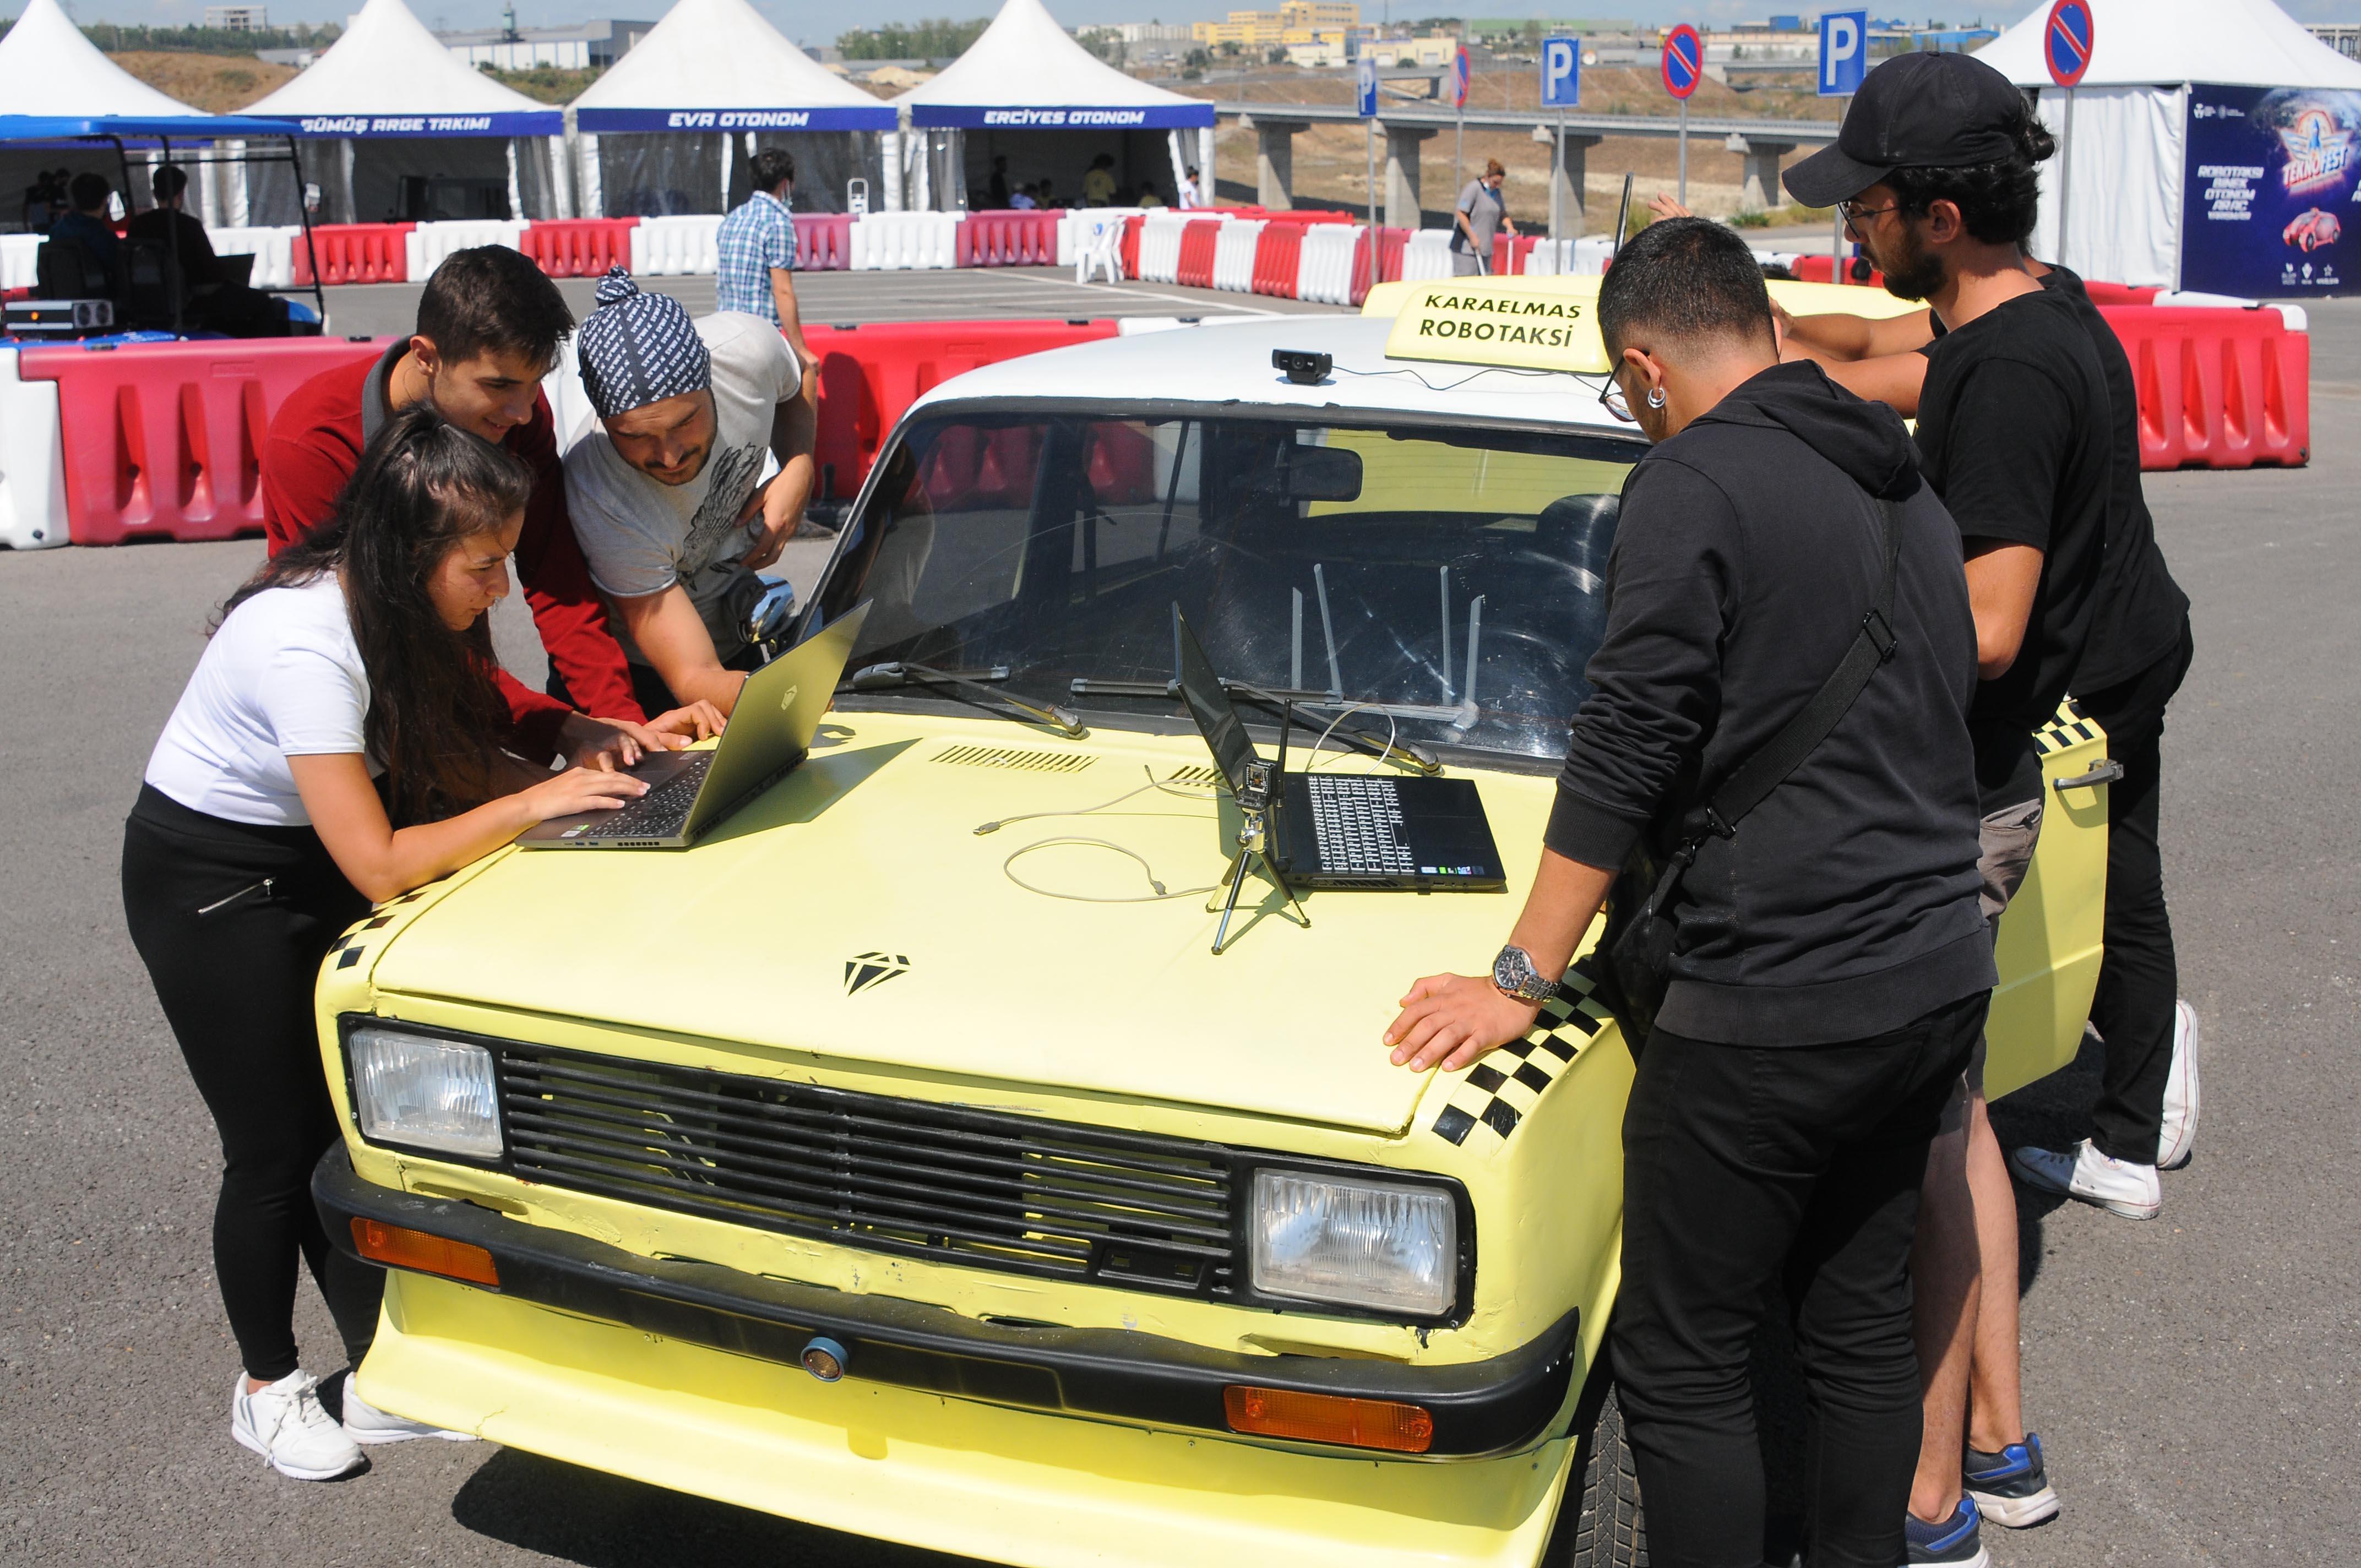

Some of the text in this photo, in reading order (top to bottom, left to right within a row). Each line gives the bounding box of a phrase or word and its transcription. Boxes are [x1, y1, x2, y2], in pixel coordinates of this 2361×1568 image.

[1826, 17, 1858, 86] P
[1548, 43, 1573, 100] P
[1361, 66, 1373, 112] P
[371, 118, 426, 132] ARGE
[427, 117, 492, 131] TAKIMI
[718, 112, 810, 127] OTONOM
[984, 108, 1145, 124] ERCİYES OTONOM
[1424, 295, 1581, 318] KARAELMAS
[1419, 318, 1573, 347] ROBOTAKSİ
